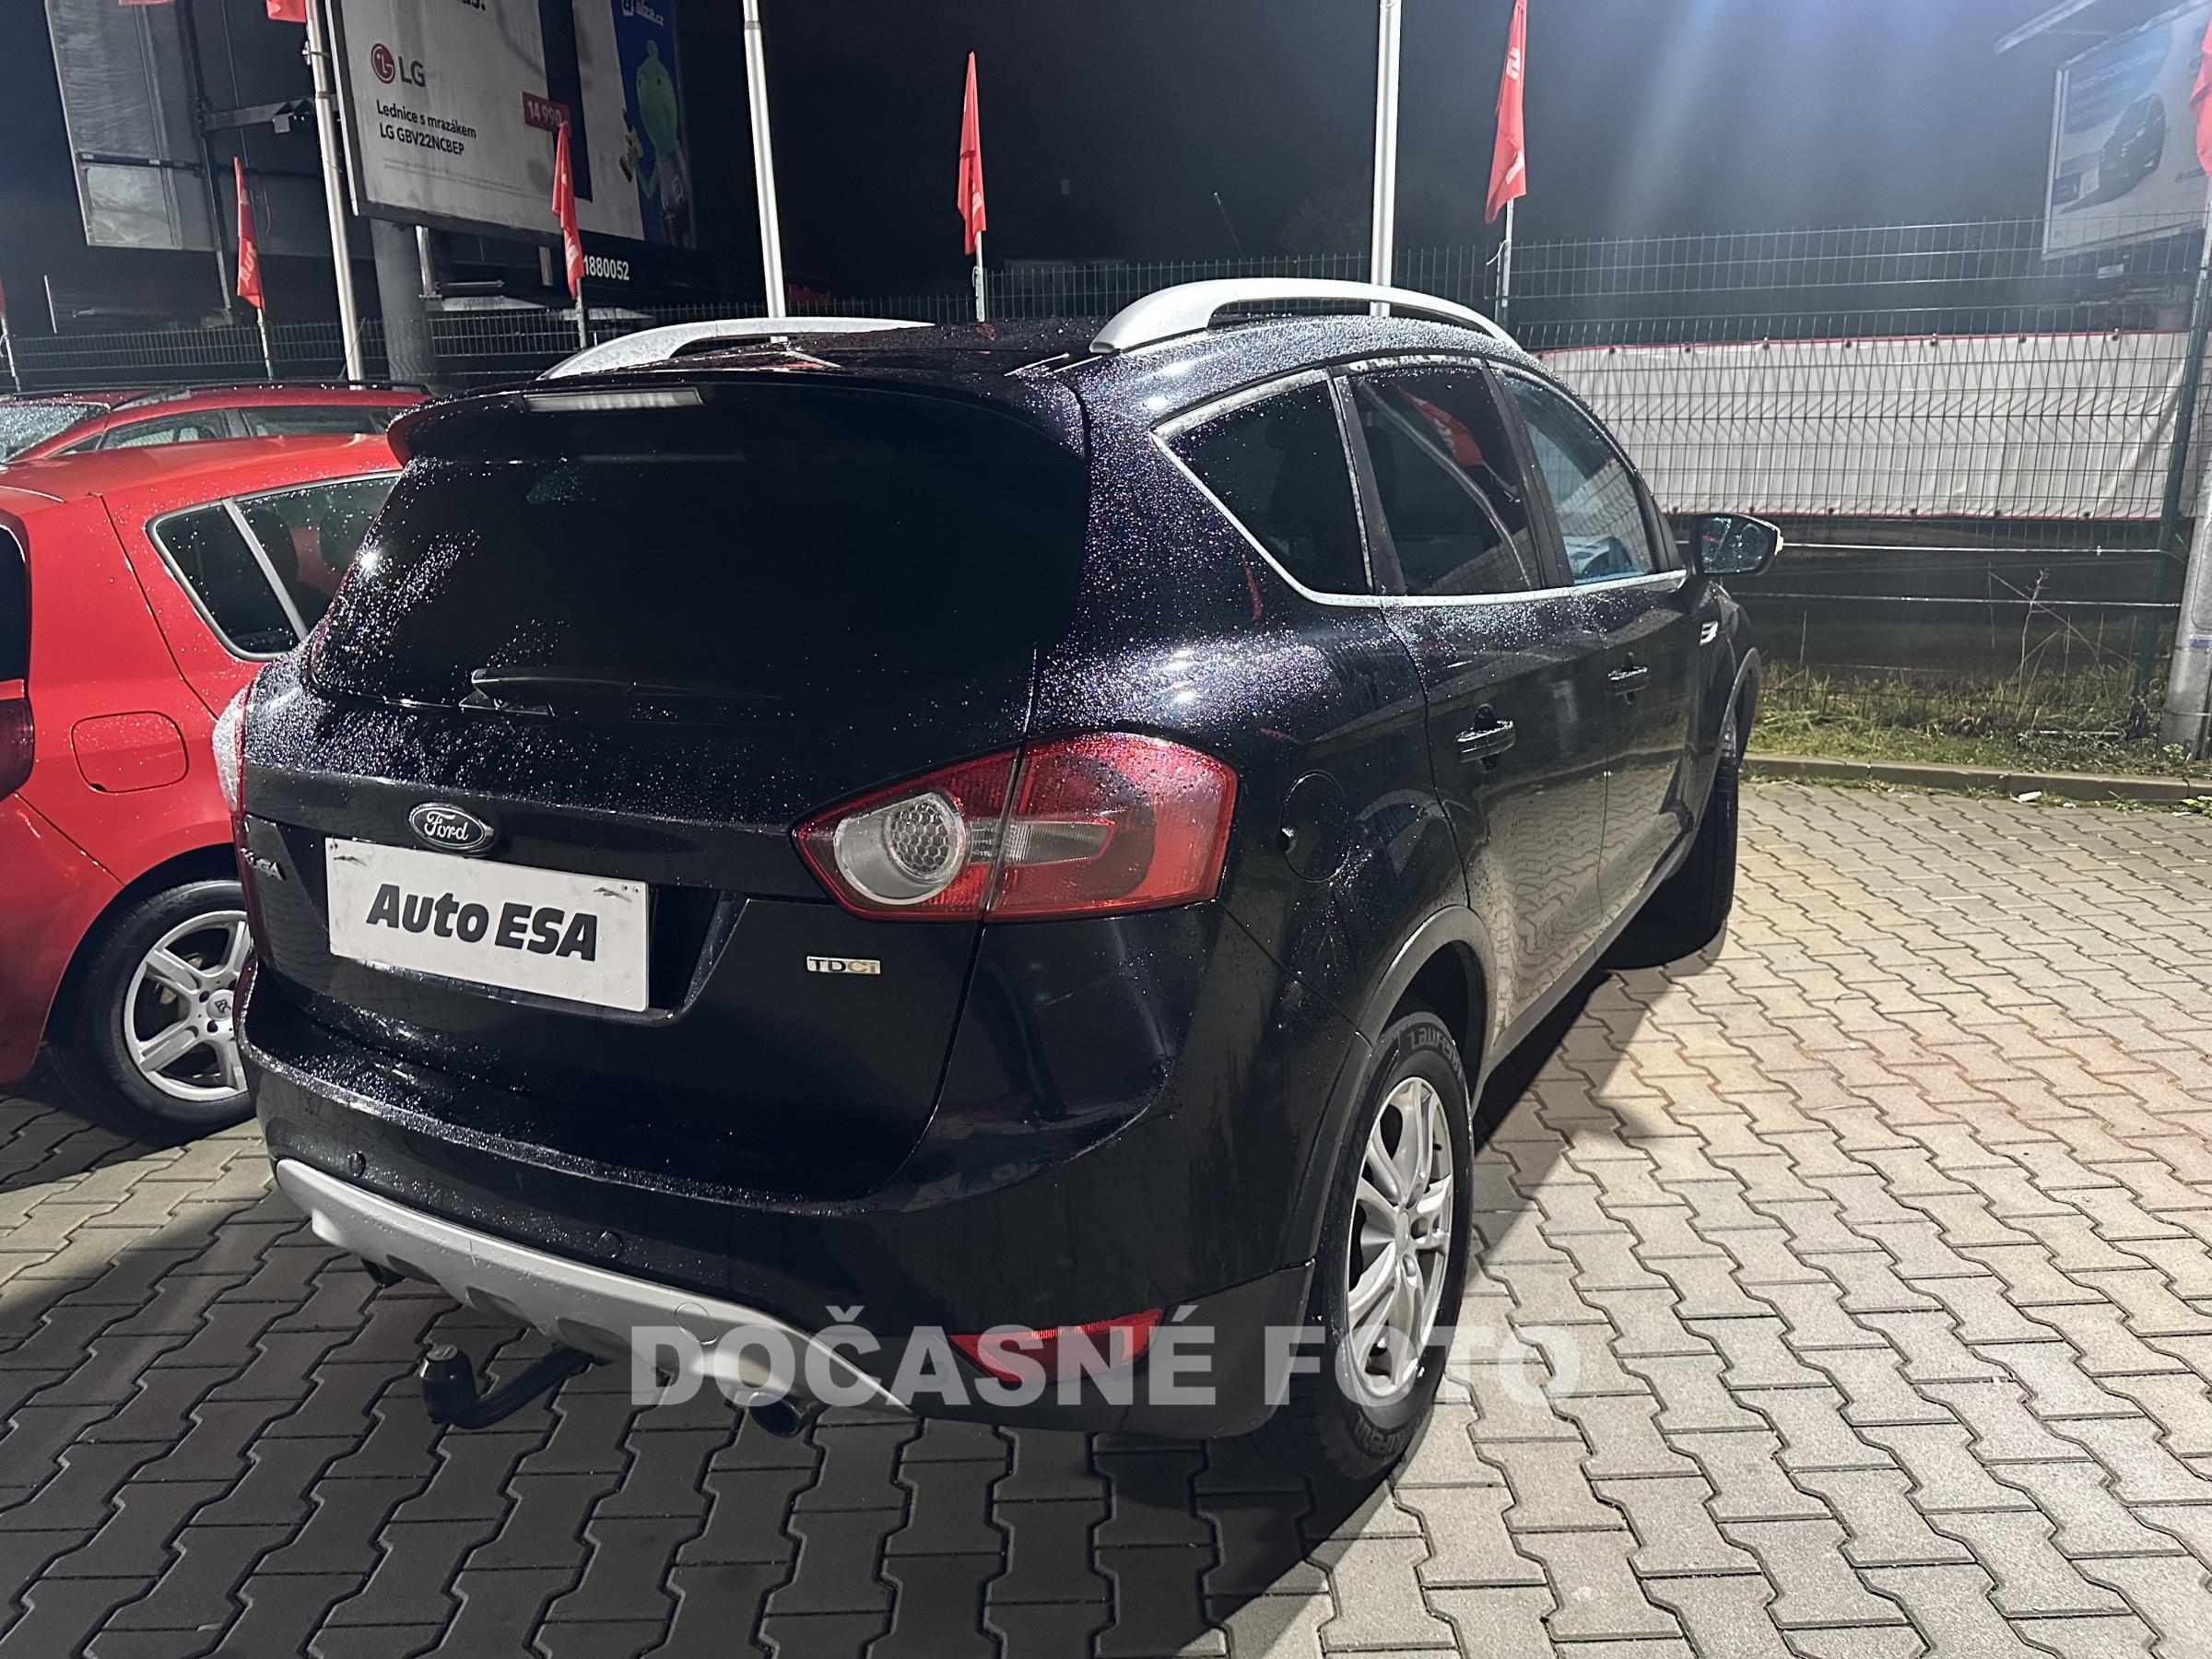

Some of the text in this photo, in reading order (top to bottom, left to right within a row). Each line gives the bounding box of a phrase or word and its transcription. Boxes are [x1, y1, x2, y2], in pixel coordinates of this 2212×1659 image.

[398, 55, 426, 87] LG
[376, 99, 477, 139] Lednice s mrazákem
[380, 123, 465, 155] LG GBV22NCBEP
[583, 255, 629, 281] 1880052
[423, 810, 470, 842] Ford
[366, 883, 597, 961] Auto ESA
